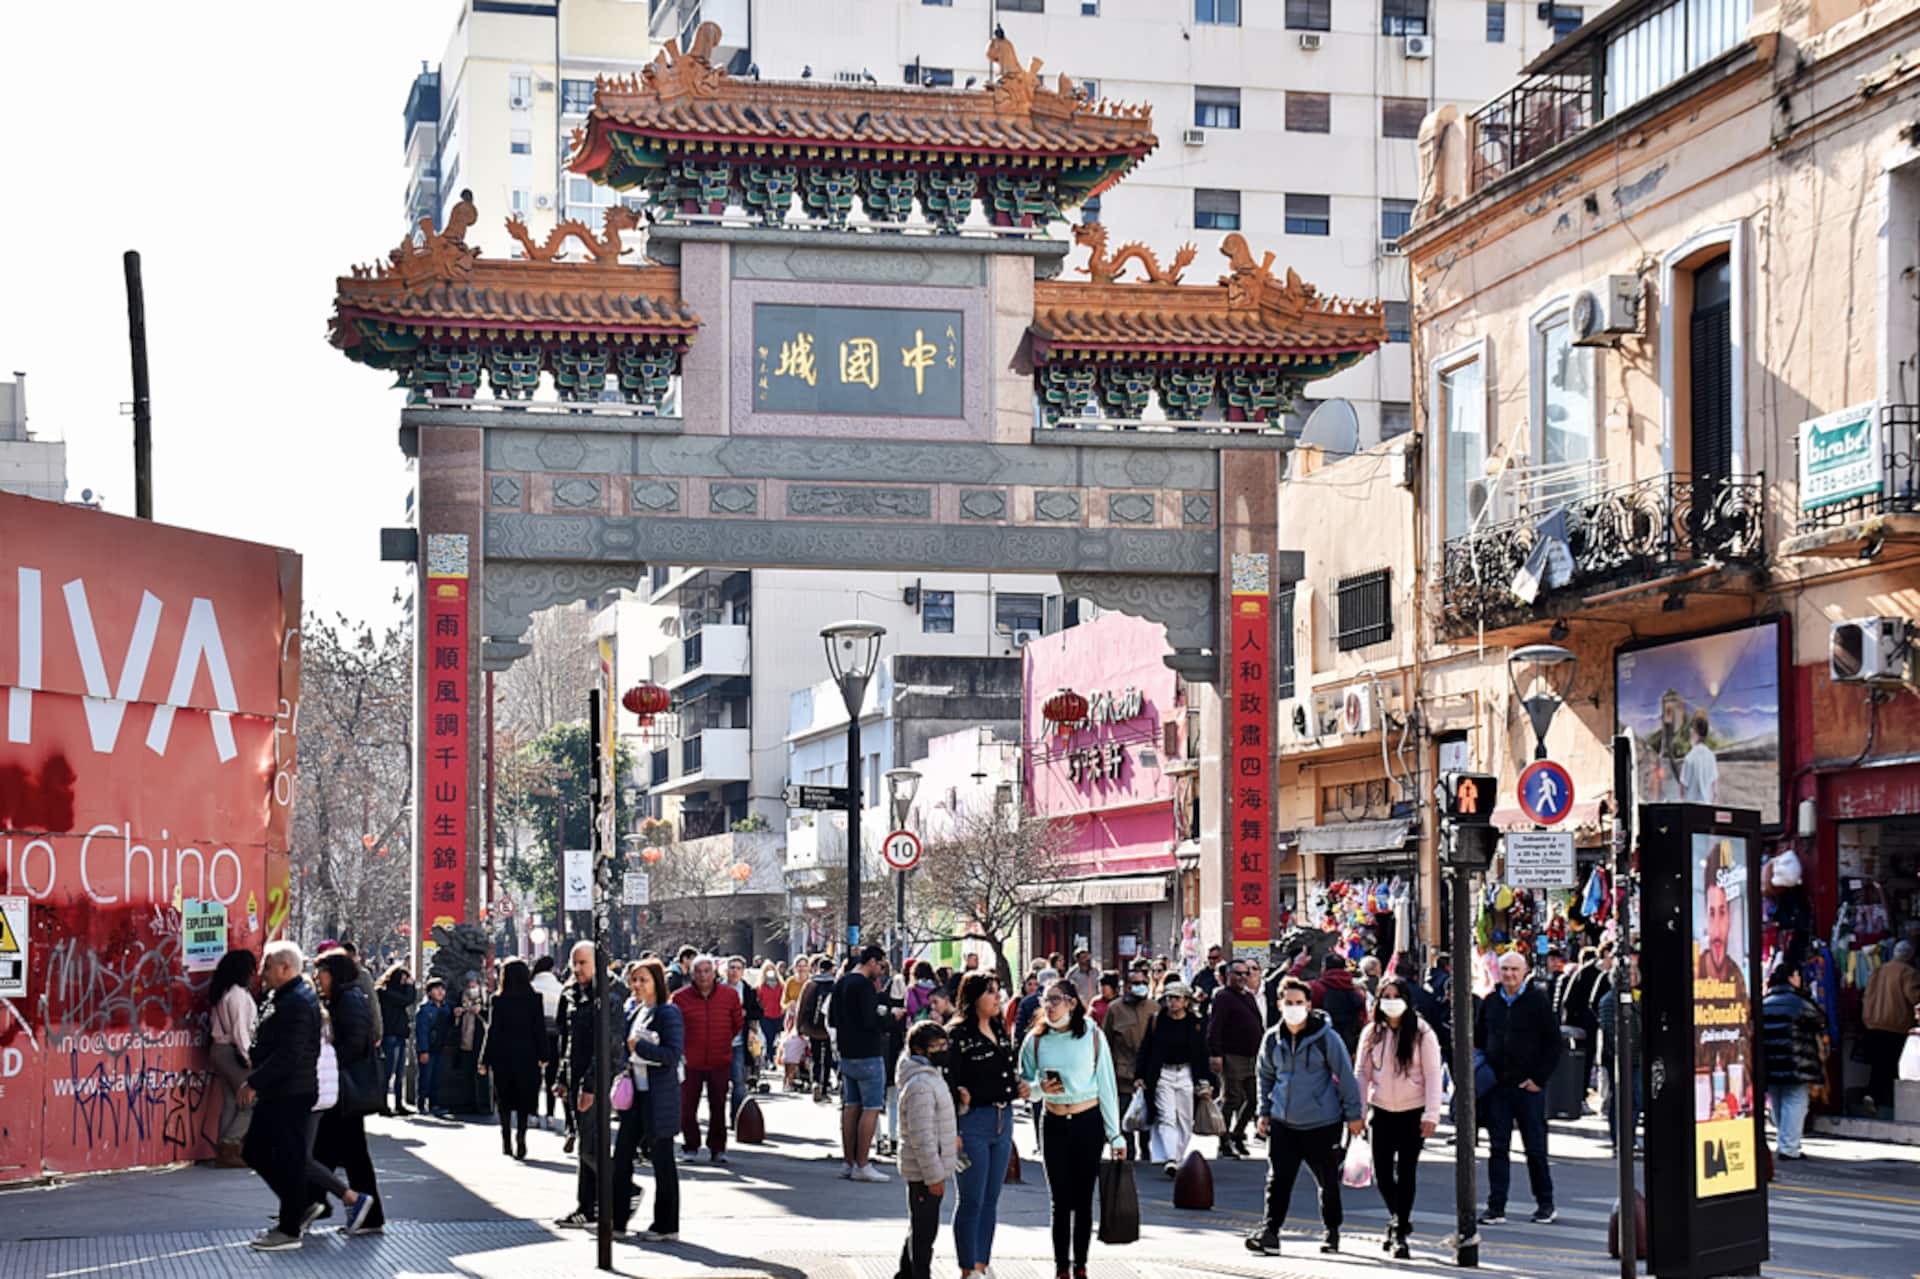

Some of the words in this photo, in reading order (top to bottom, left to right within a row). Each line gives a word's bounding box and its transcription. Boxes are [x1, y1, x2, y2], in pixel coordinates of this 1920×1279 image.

[774, 328, 938, 397] 中國城
[0, 819, 56, 899] io
[80, 821, 242, 904] Chino
[891, 842, 913, 857] 10
